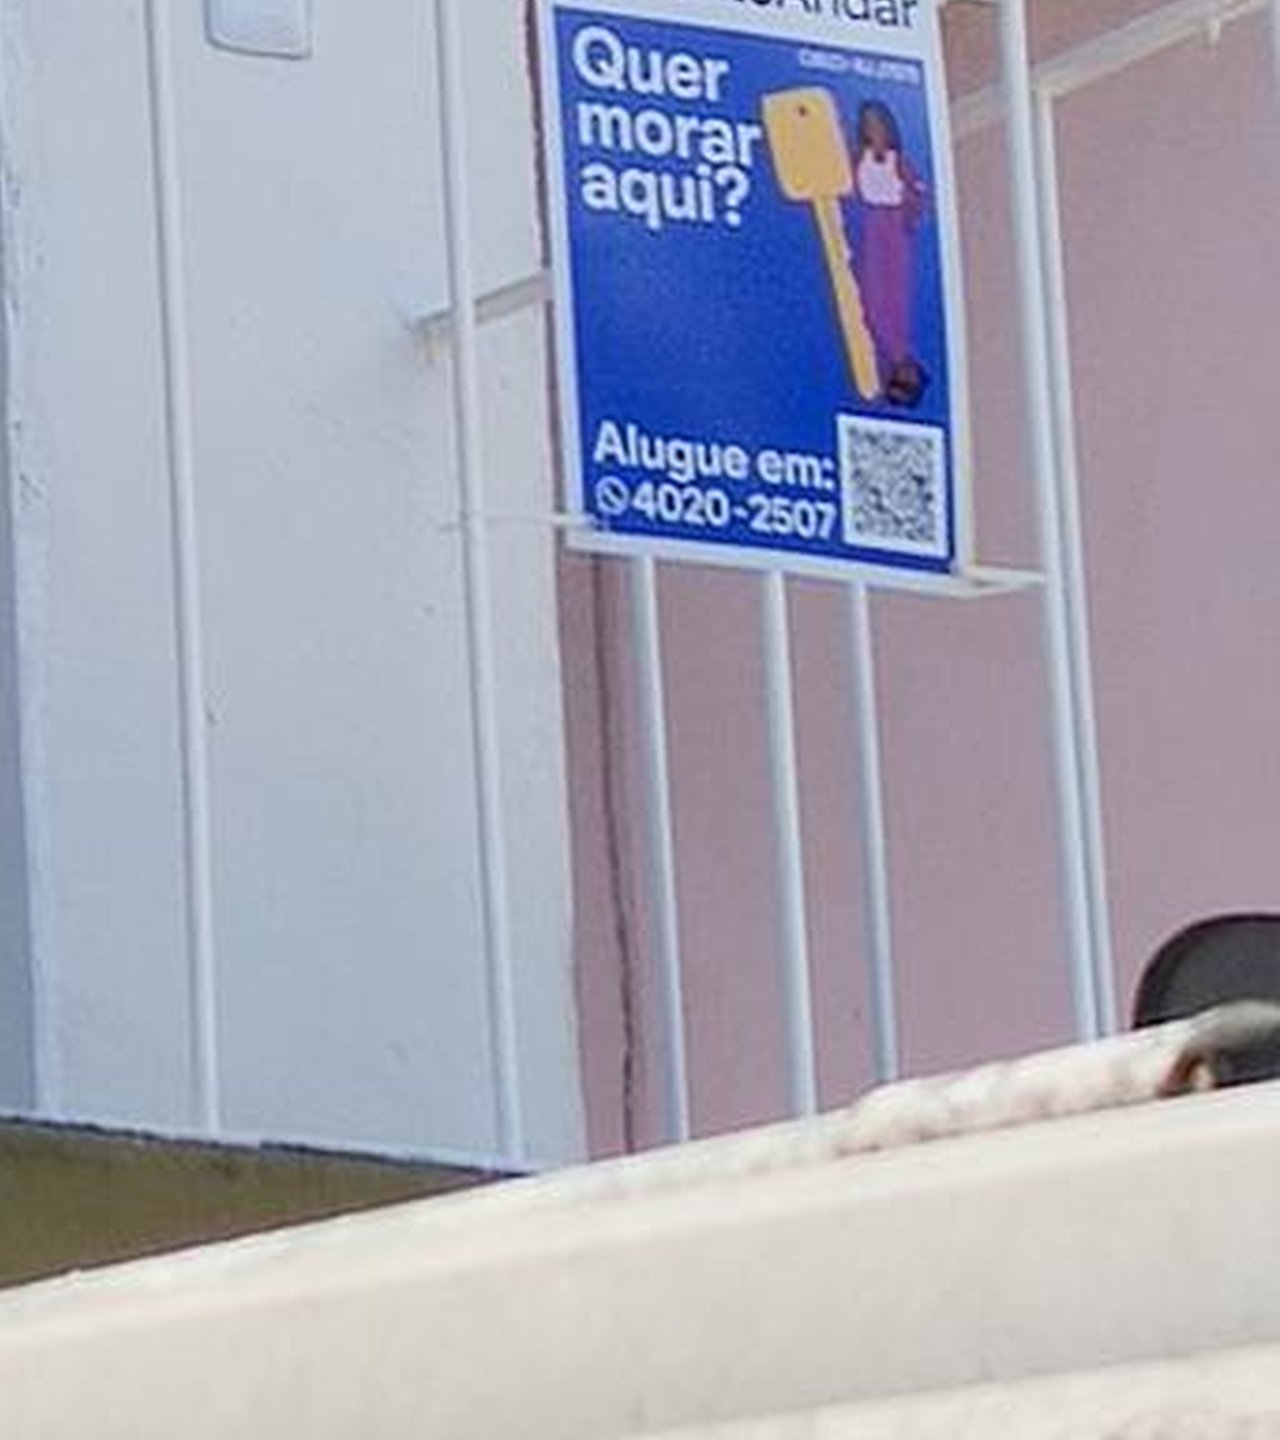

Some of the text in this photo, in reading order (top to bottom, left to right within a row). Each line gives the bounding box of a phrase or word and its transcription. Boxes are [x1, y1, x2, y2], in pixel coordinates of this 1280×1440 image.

[571, 25, 730, 102] Quer
[577, 99, 763, 168] morar
[581, 161, 751, 230] aqui?
[593, 419, 836, 492] Alugue em:
